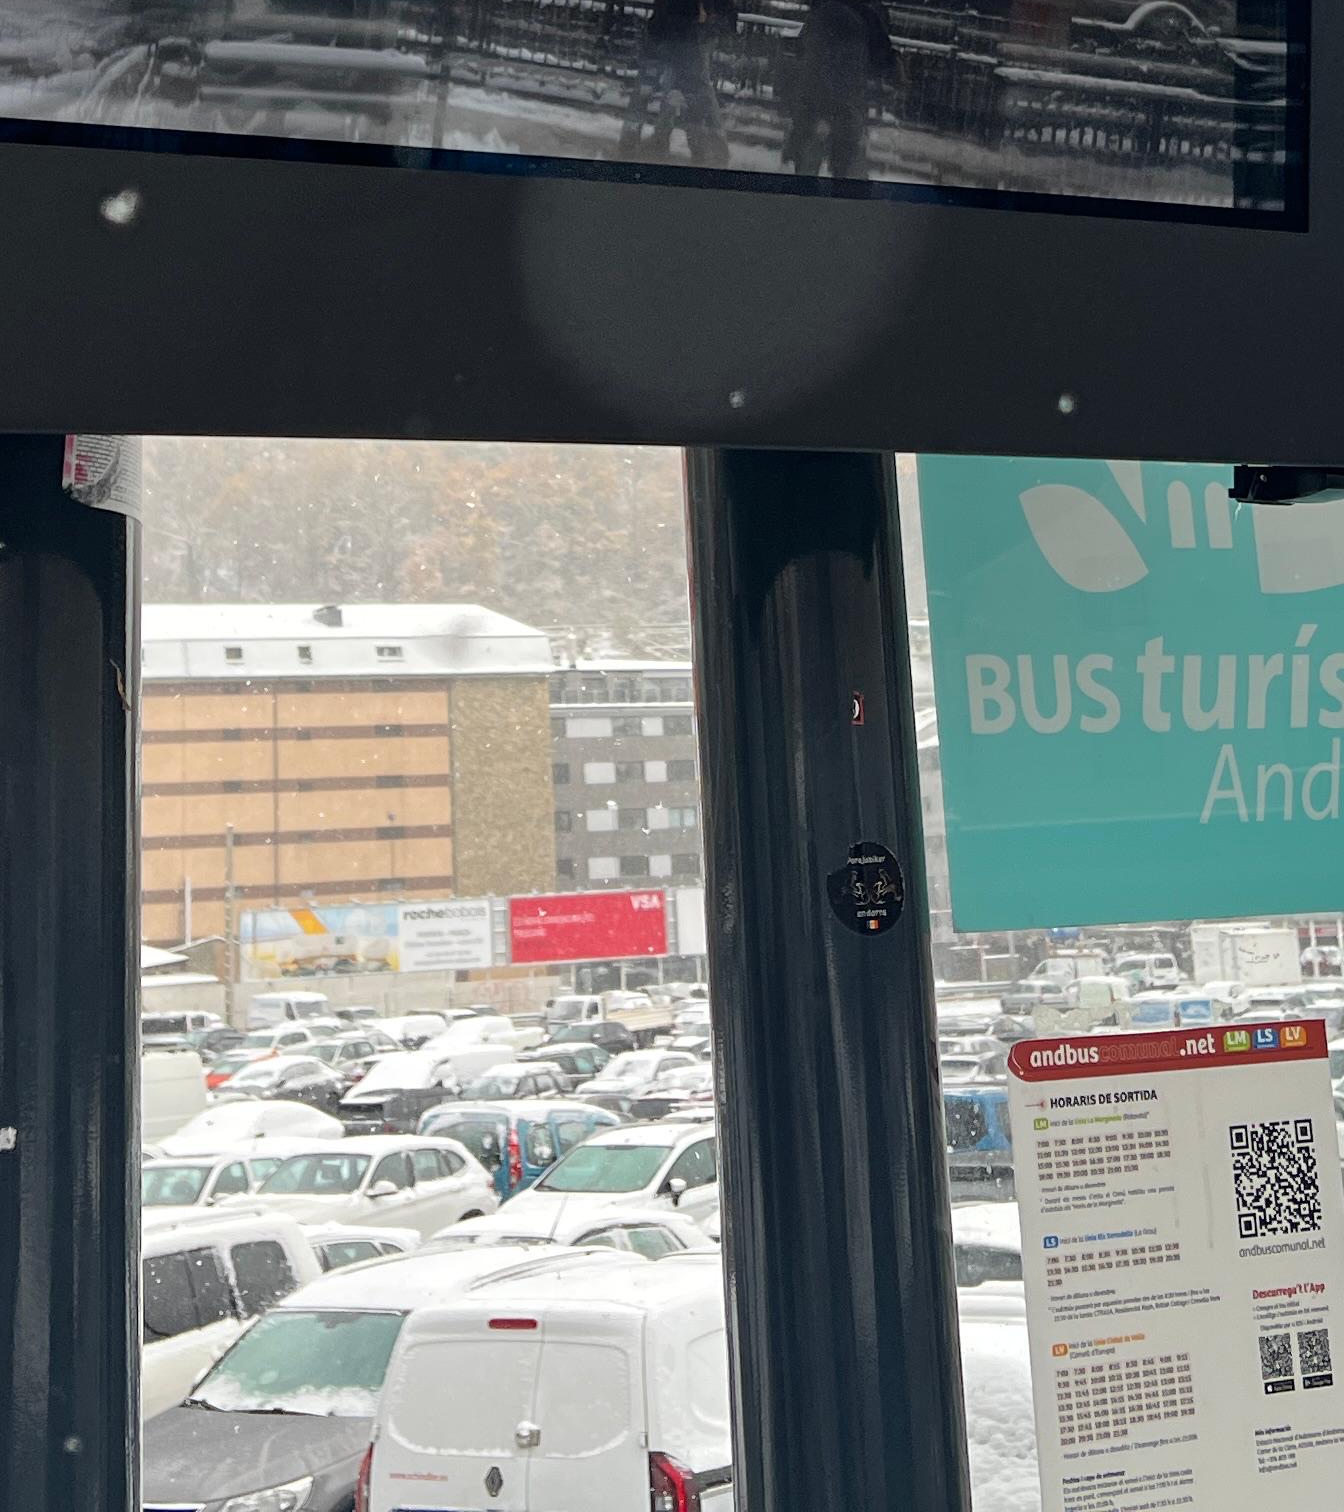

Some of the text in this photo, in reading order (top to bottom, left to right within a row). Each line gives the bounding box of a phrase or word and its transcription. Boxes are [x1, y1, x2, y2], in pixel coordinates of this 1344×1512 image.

[965, 654, 1121, 735] BUS
[1227, 1028, 1300, 1045] LM LS LV
[1050, 1090, 1158, 1109] HORARIS DE SORTIDA
[1239, 1238, 1325, 1258] andbuscomunal.net
